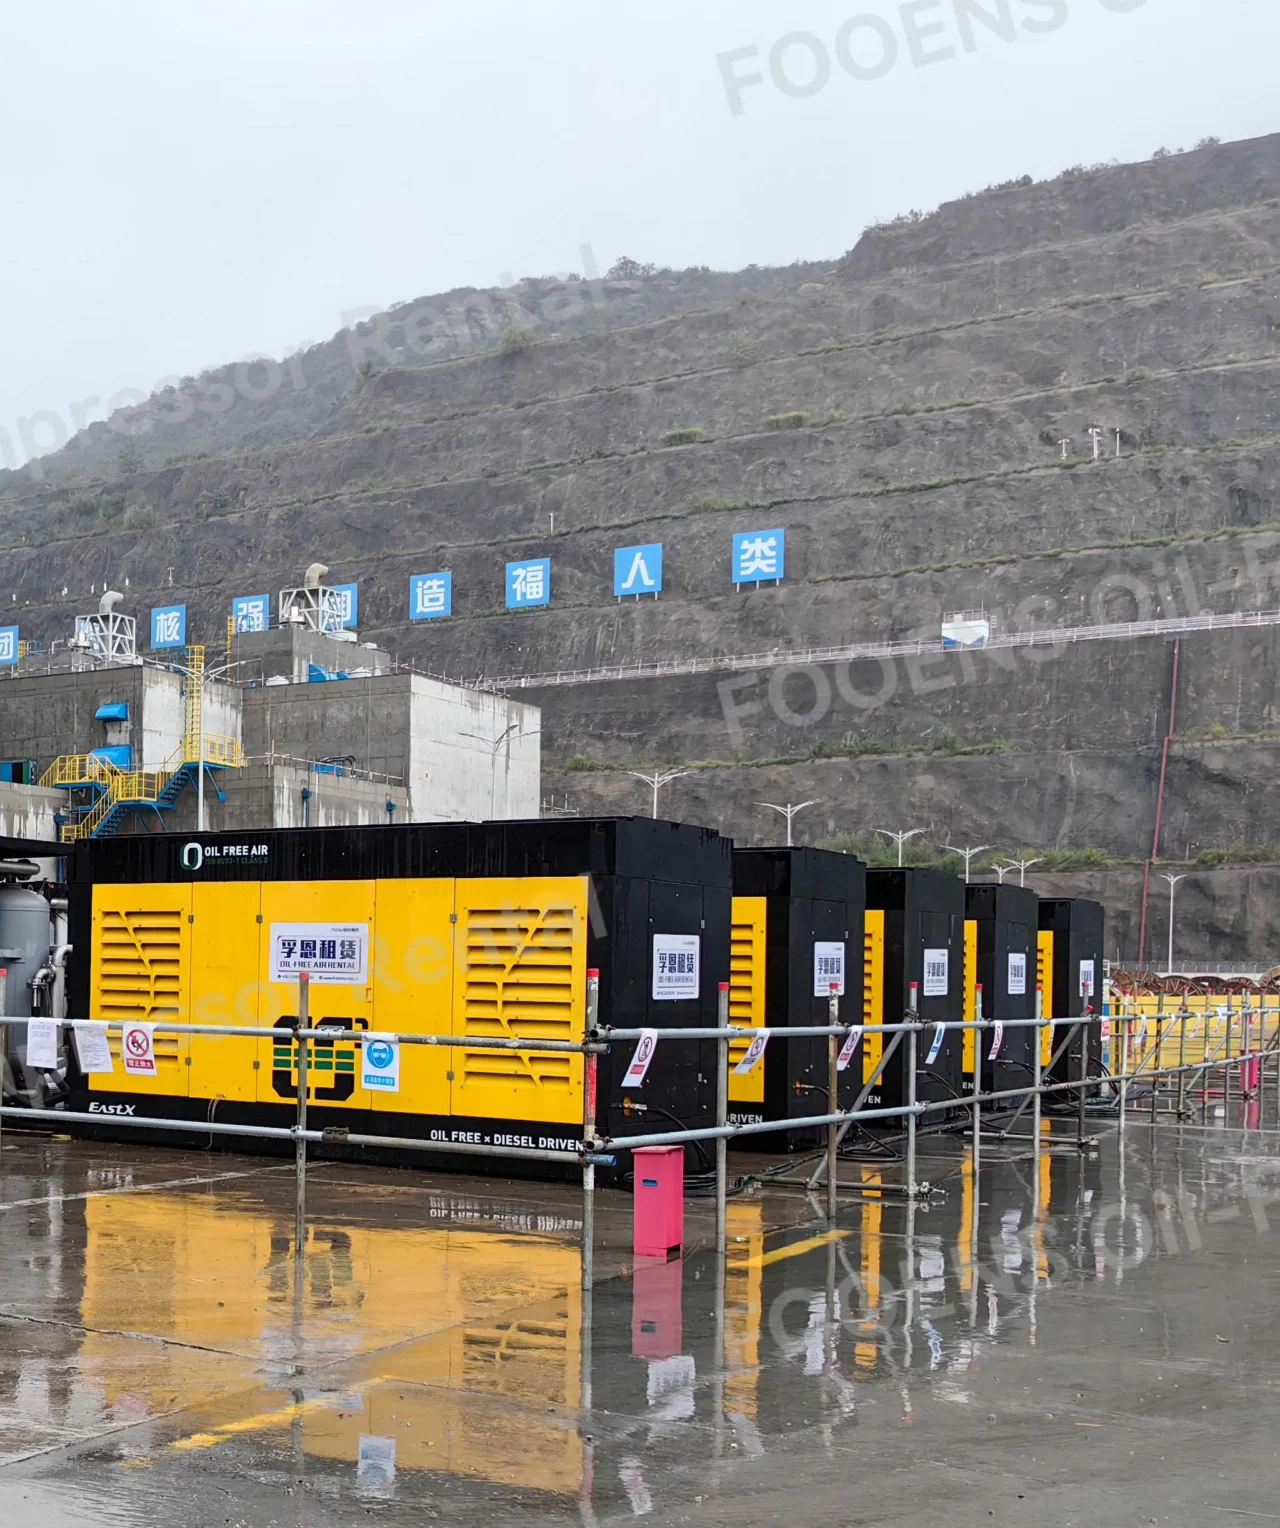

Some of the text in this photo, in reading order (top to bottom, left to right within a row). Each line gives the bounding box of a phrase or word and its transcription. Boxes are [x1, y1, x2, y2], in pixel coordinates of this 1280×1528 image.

[204, 844, 269, 857] OIL FREE AIR
[281, 939, 357, 960] 孚恩租赁
[328, 961, 355, 969] RENTAL
[728, 1113, 763, 1124] RIVEN
[430, 1129, 448, 1141] OIL
[451, 1131, 481, 1143] FREE
[493, 1134, 536, 1147] DIESEL
[538, 1137, 584, 1151] DRIVEN
